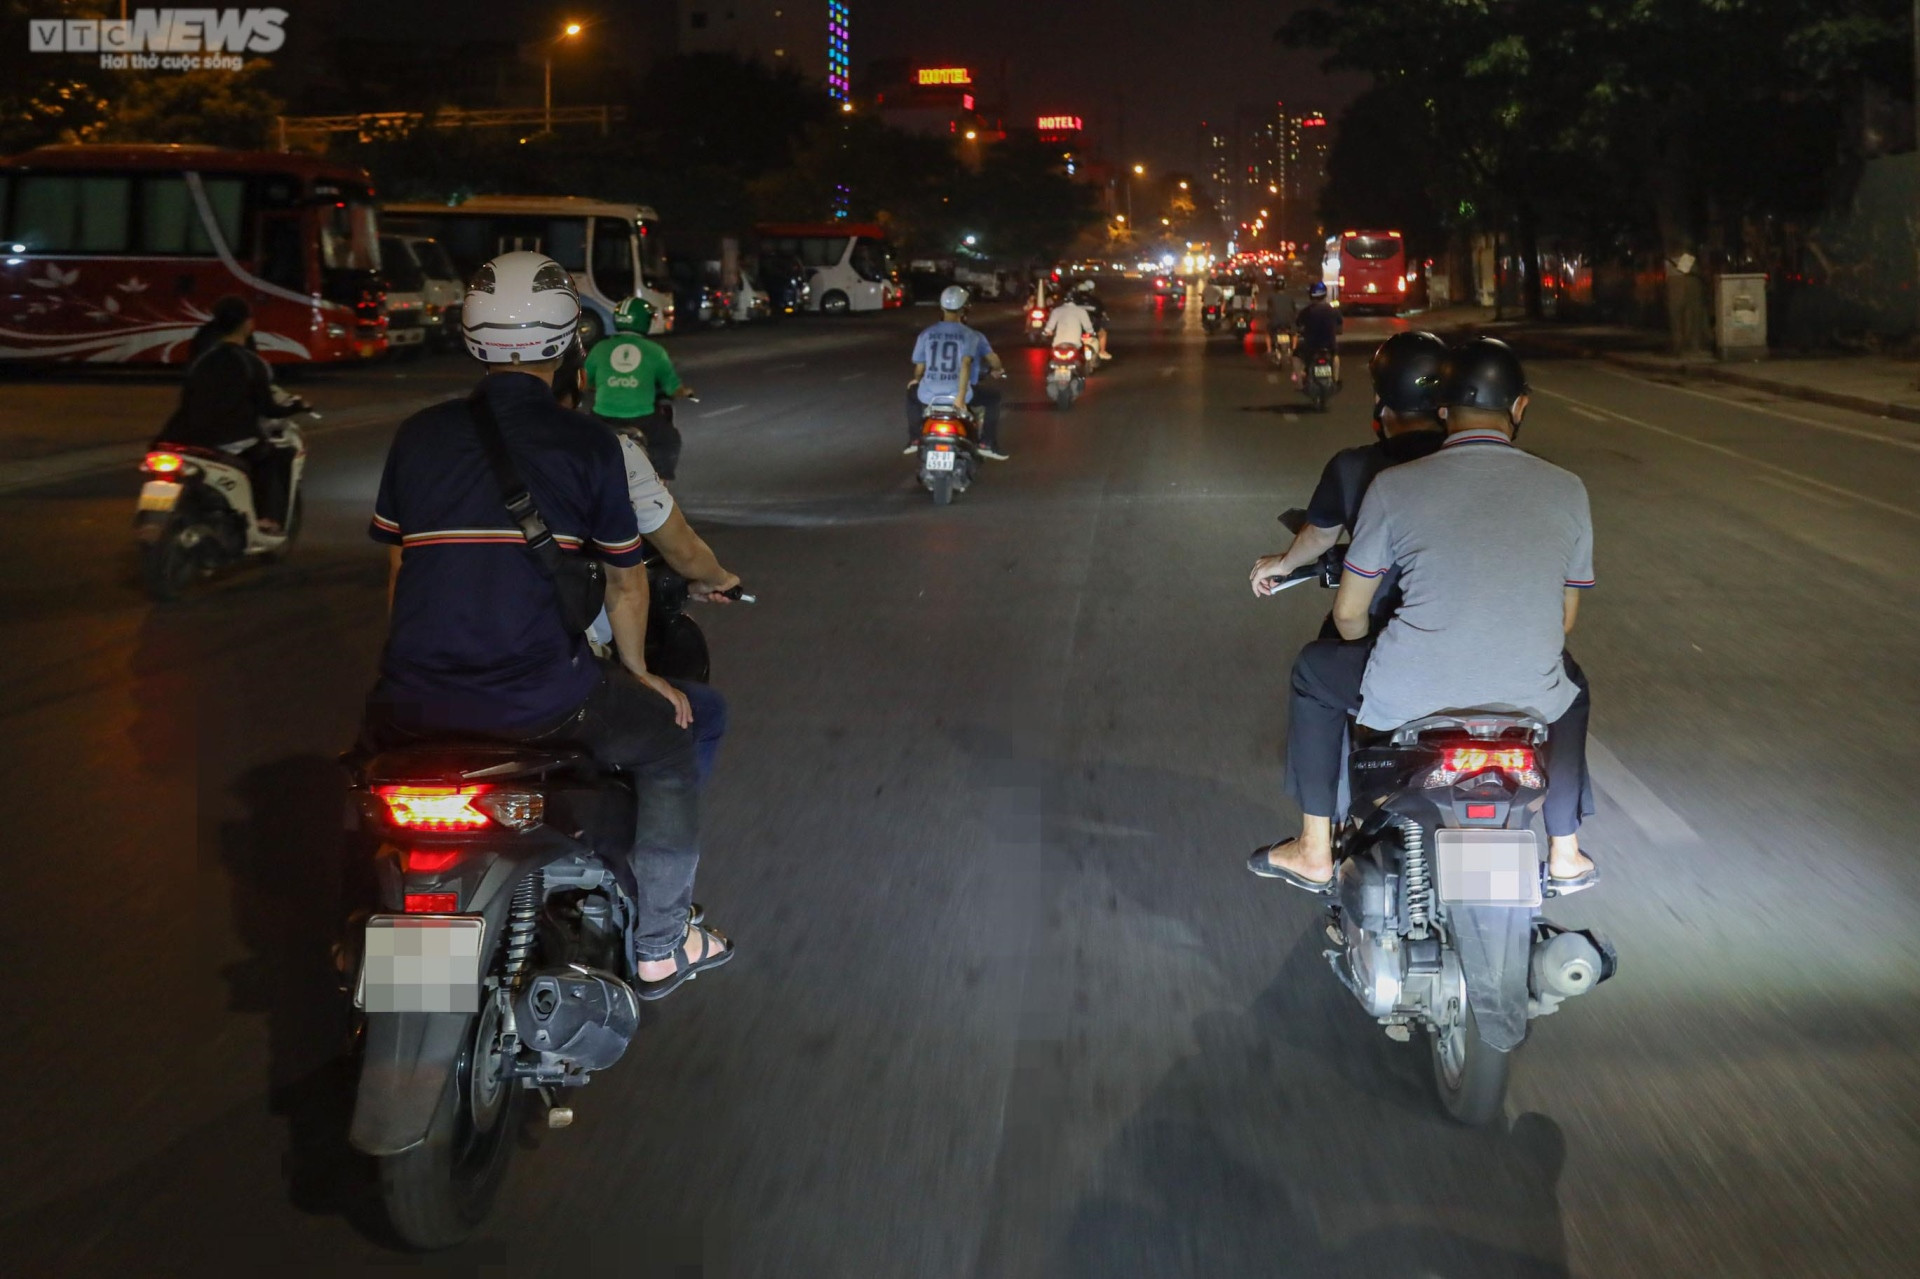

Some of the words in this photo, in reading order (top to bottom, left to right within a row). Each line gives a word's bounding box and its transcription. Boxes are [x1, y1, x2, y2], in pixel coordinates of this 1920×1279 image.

[918, 68, 972, 84] HOTEL
[1038, 116, 1075, 130] HOTEL
[928, 340, 958, 372] 19
[607, 375, 639, 388] Grab
